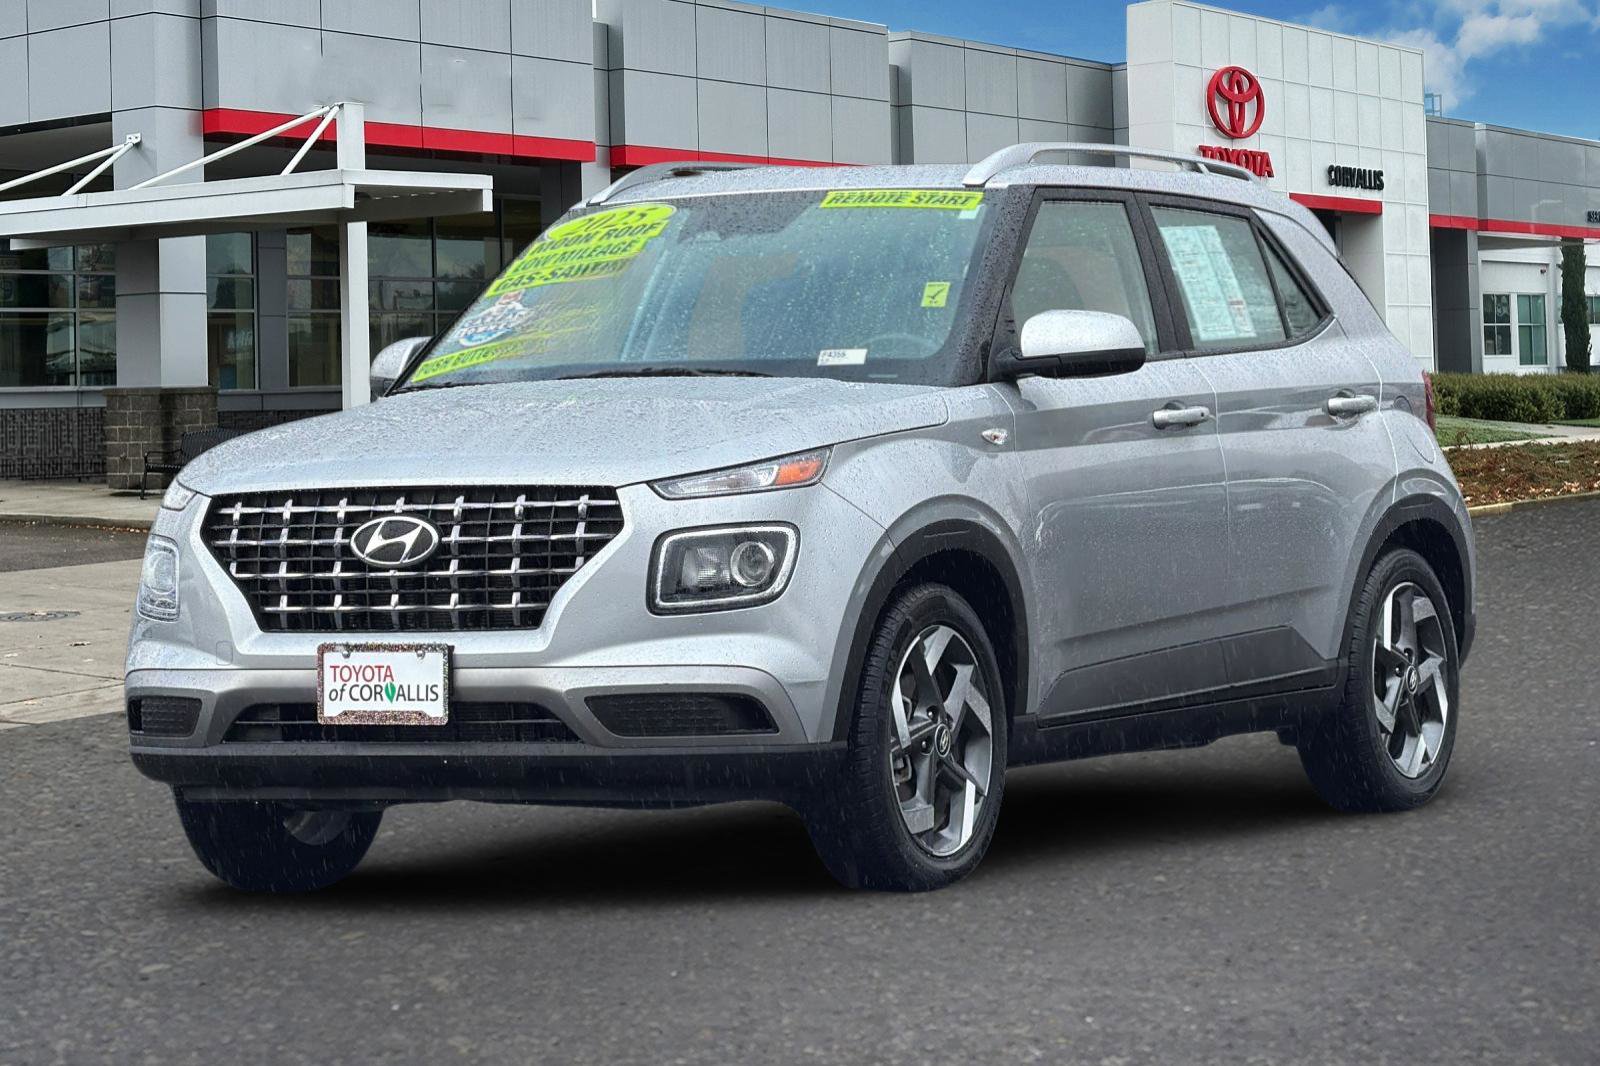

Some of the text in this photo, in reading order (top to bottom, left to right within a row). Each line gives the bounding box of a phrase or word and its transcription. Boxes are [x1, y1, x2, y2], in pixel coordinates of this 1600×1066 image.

[1198, 145, 1275, 178] TOYOTA
[1328, 165, 1384, 191] CORVALLIS
[827, 191, 977, 206] REMOTE START
[530, 222, 661, 252] MOON ROOF
[512, 240, 639, 276] LOW MILEAGE
[330, 665, 394, 683] TOYOTA
[328, 682, 439, 703] of CORVALLIS
